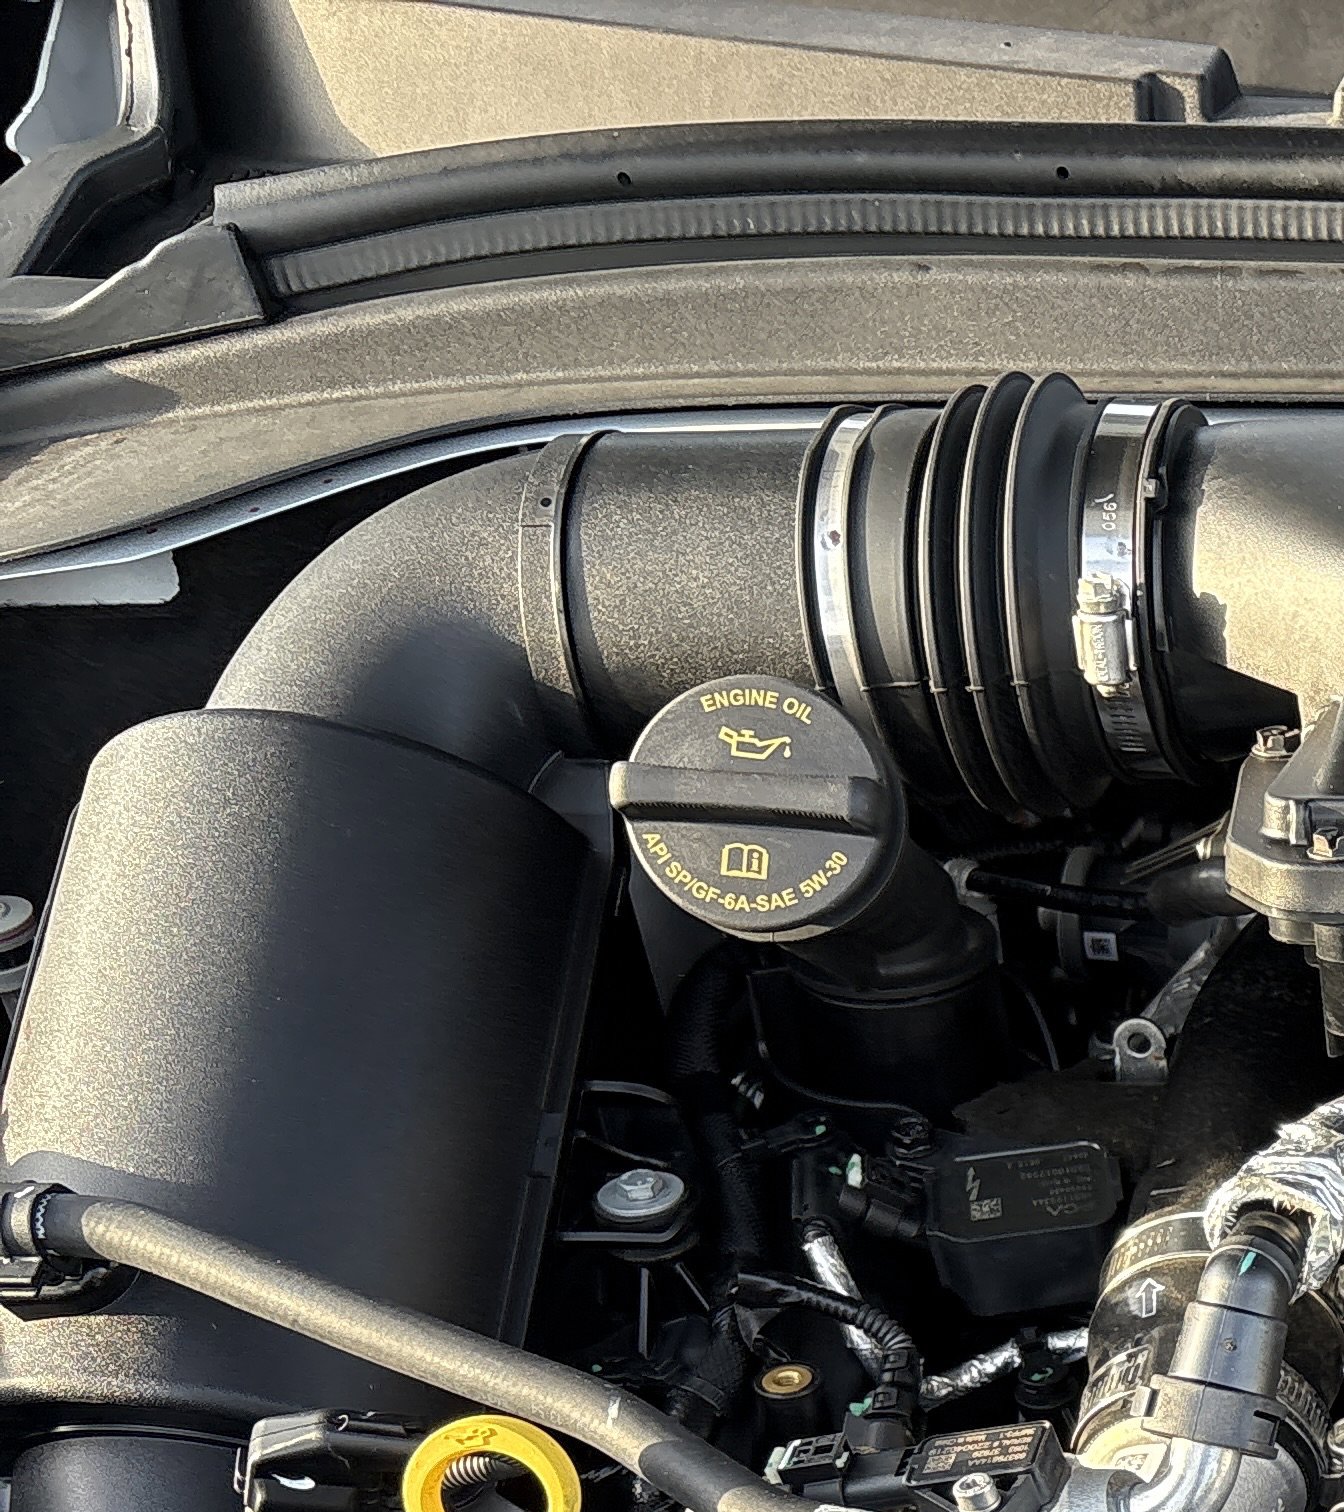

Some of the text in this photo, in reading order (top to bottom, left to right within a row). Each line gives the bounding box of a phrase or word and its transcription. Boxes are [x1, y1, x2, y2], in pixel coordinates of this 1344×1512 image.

[700, 688, 813, 725] ENGINE OIL
[642, 833, 848, 912] API SP/GF-6A-SAE 5W-30
